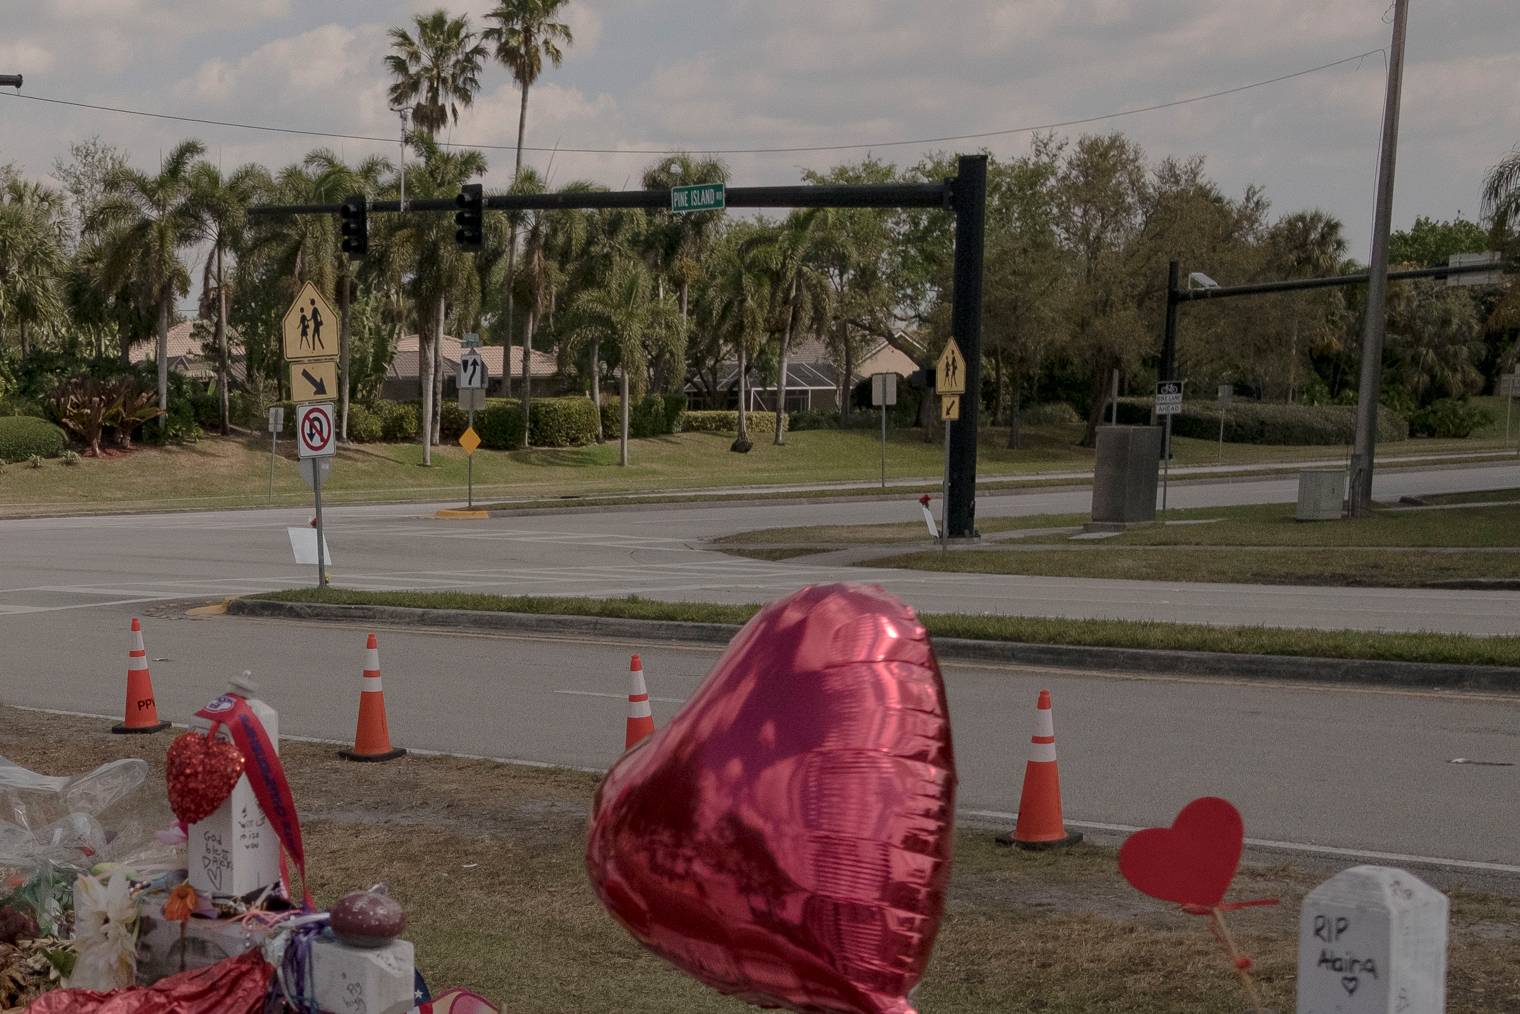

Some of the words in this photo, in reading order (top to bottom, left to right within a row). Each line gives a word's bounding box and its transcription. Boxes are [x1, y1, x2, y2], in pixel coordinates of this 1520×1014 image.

[673, 191, 688, 207] PINE
[691, 189, 714, 206] ISLAND
[1313, 913, 1350, 943] RIP
